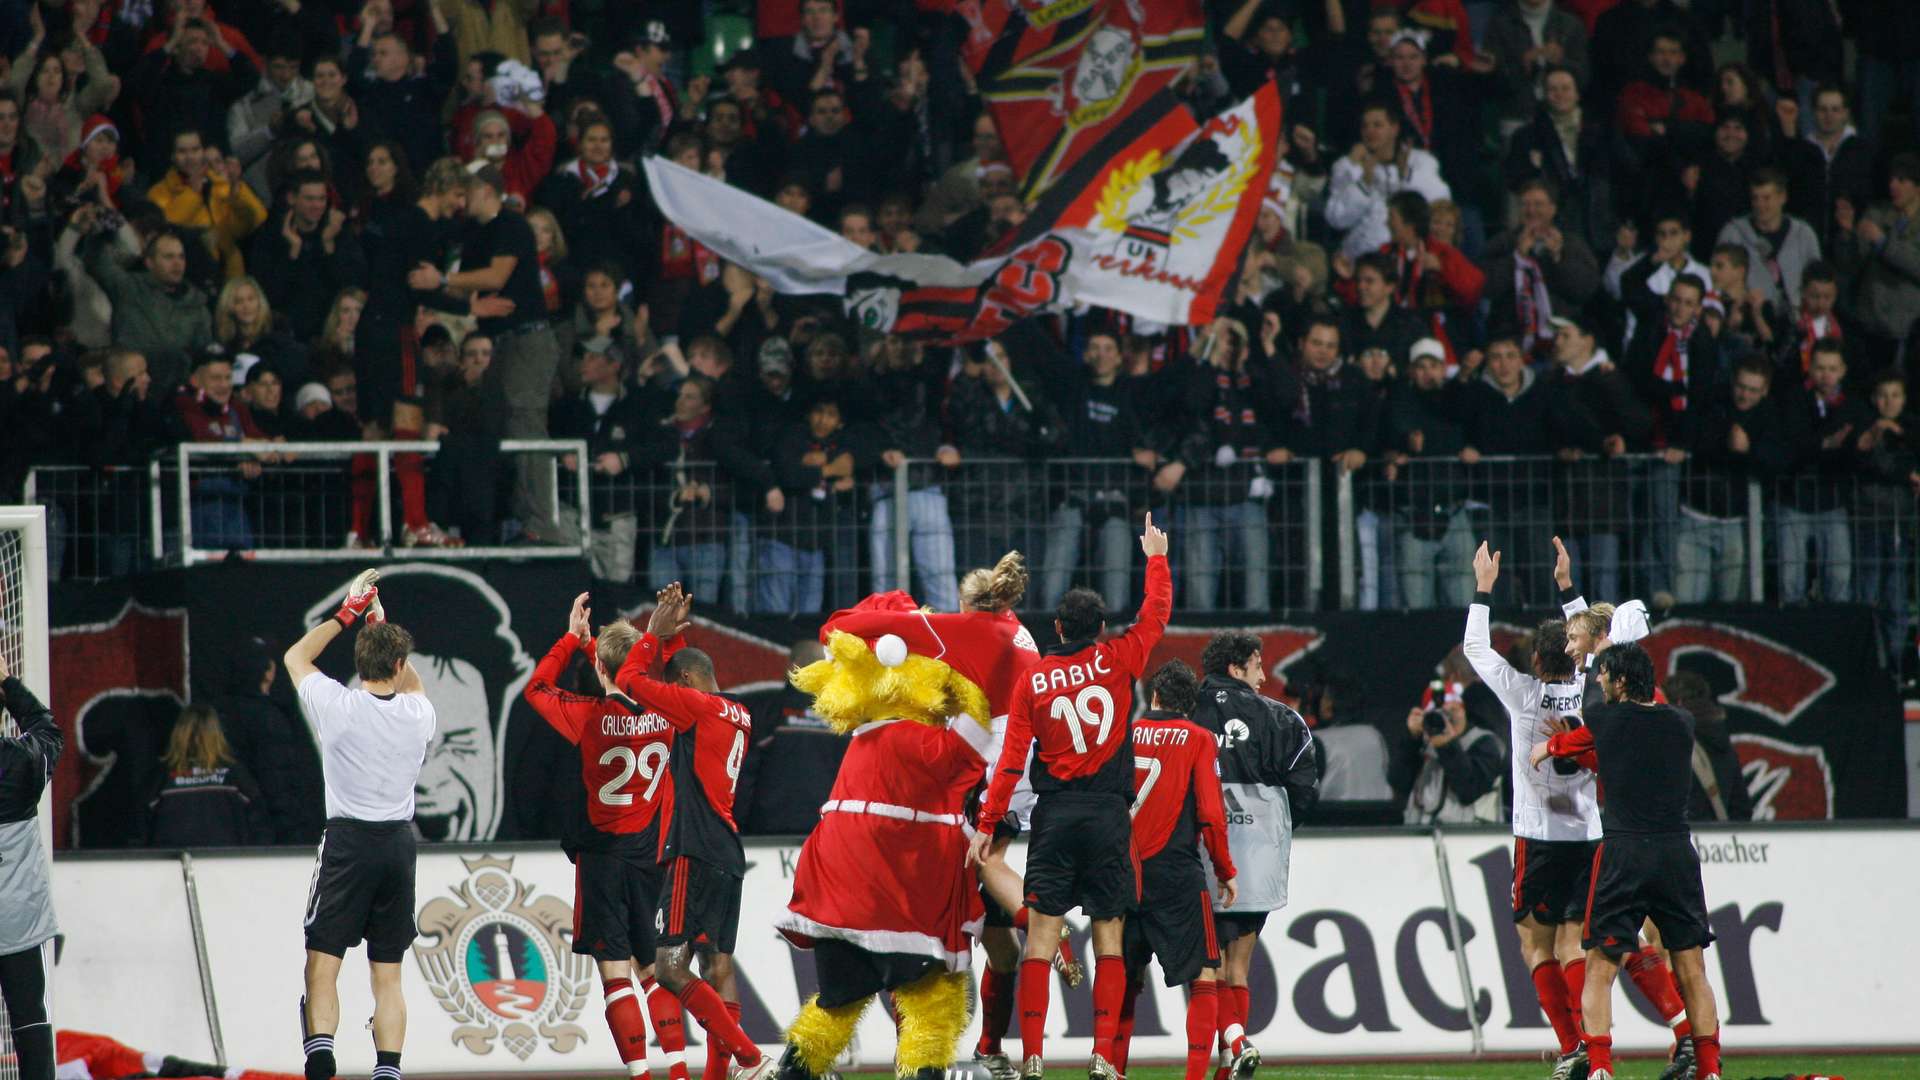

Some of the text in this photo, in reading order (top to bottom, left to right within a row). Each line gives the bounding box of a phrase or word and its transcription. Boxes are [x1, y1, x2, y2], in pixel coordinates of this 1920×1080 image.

[1050, 685, 1114, 754] 19
[1132, 727, 1189, 746] RNETTA
[599, 742, 670, 805] 29
[726, 730, 745, 794] 4
[1226, 813, 1254, 825] das
[1694, 834, 1769, 864] bacher
[655, 907, 665, 935] 4
